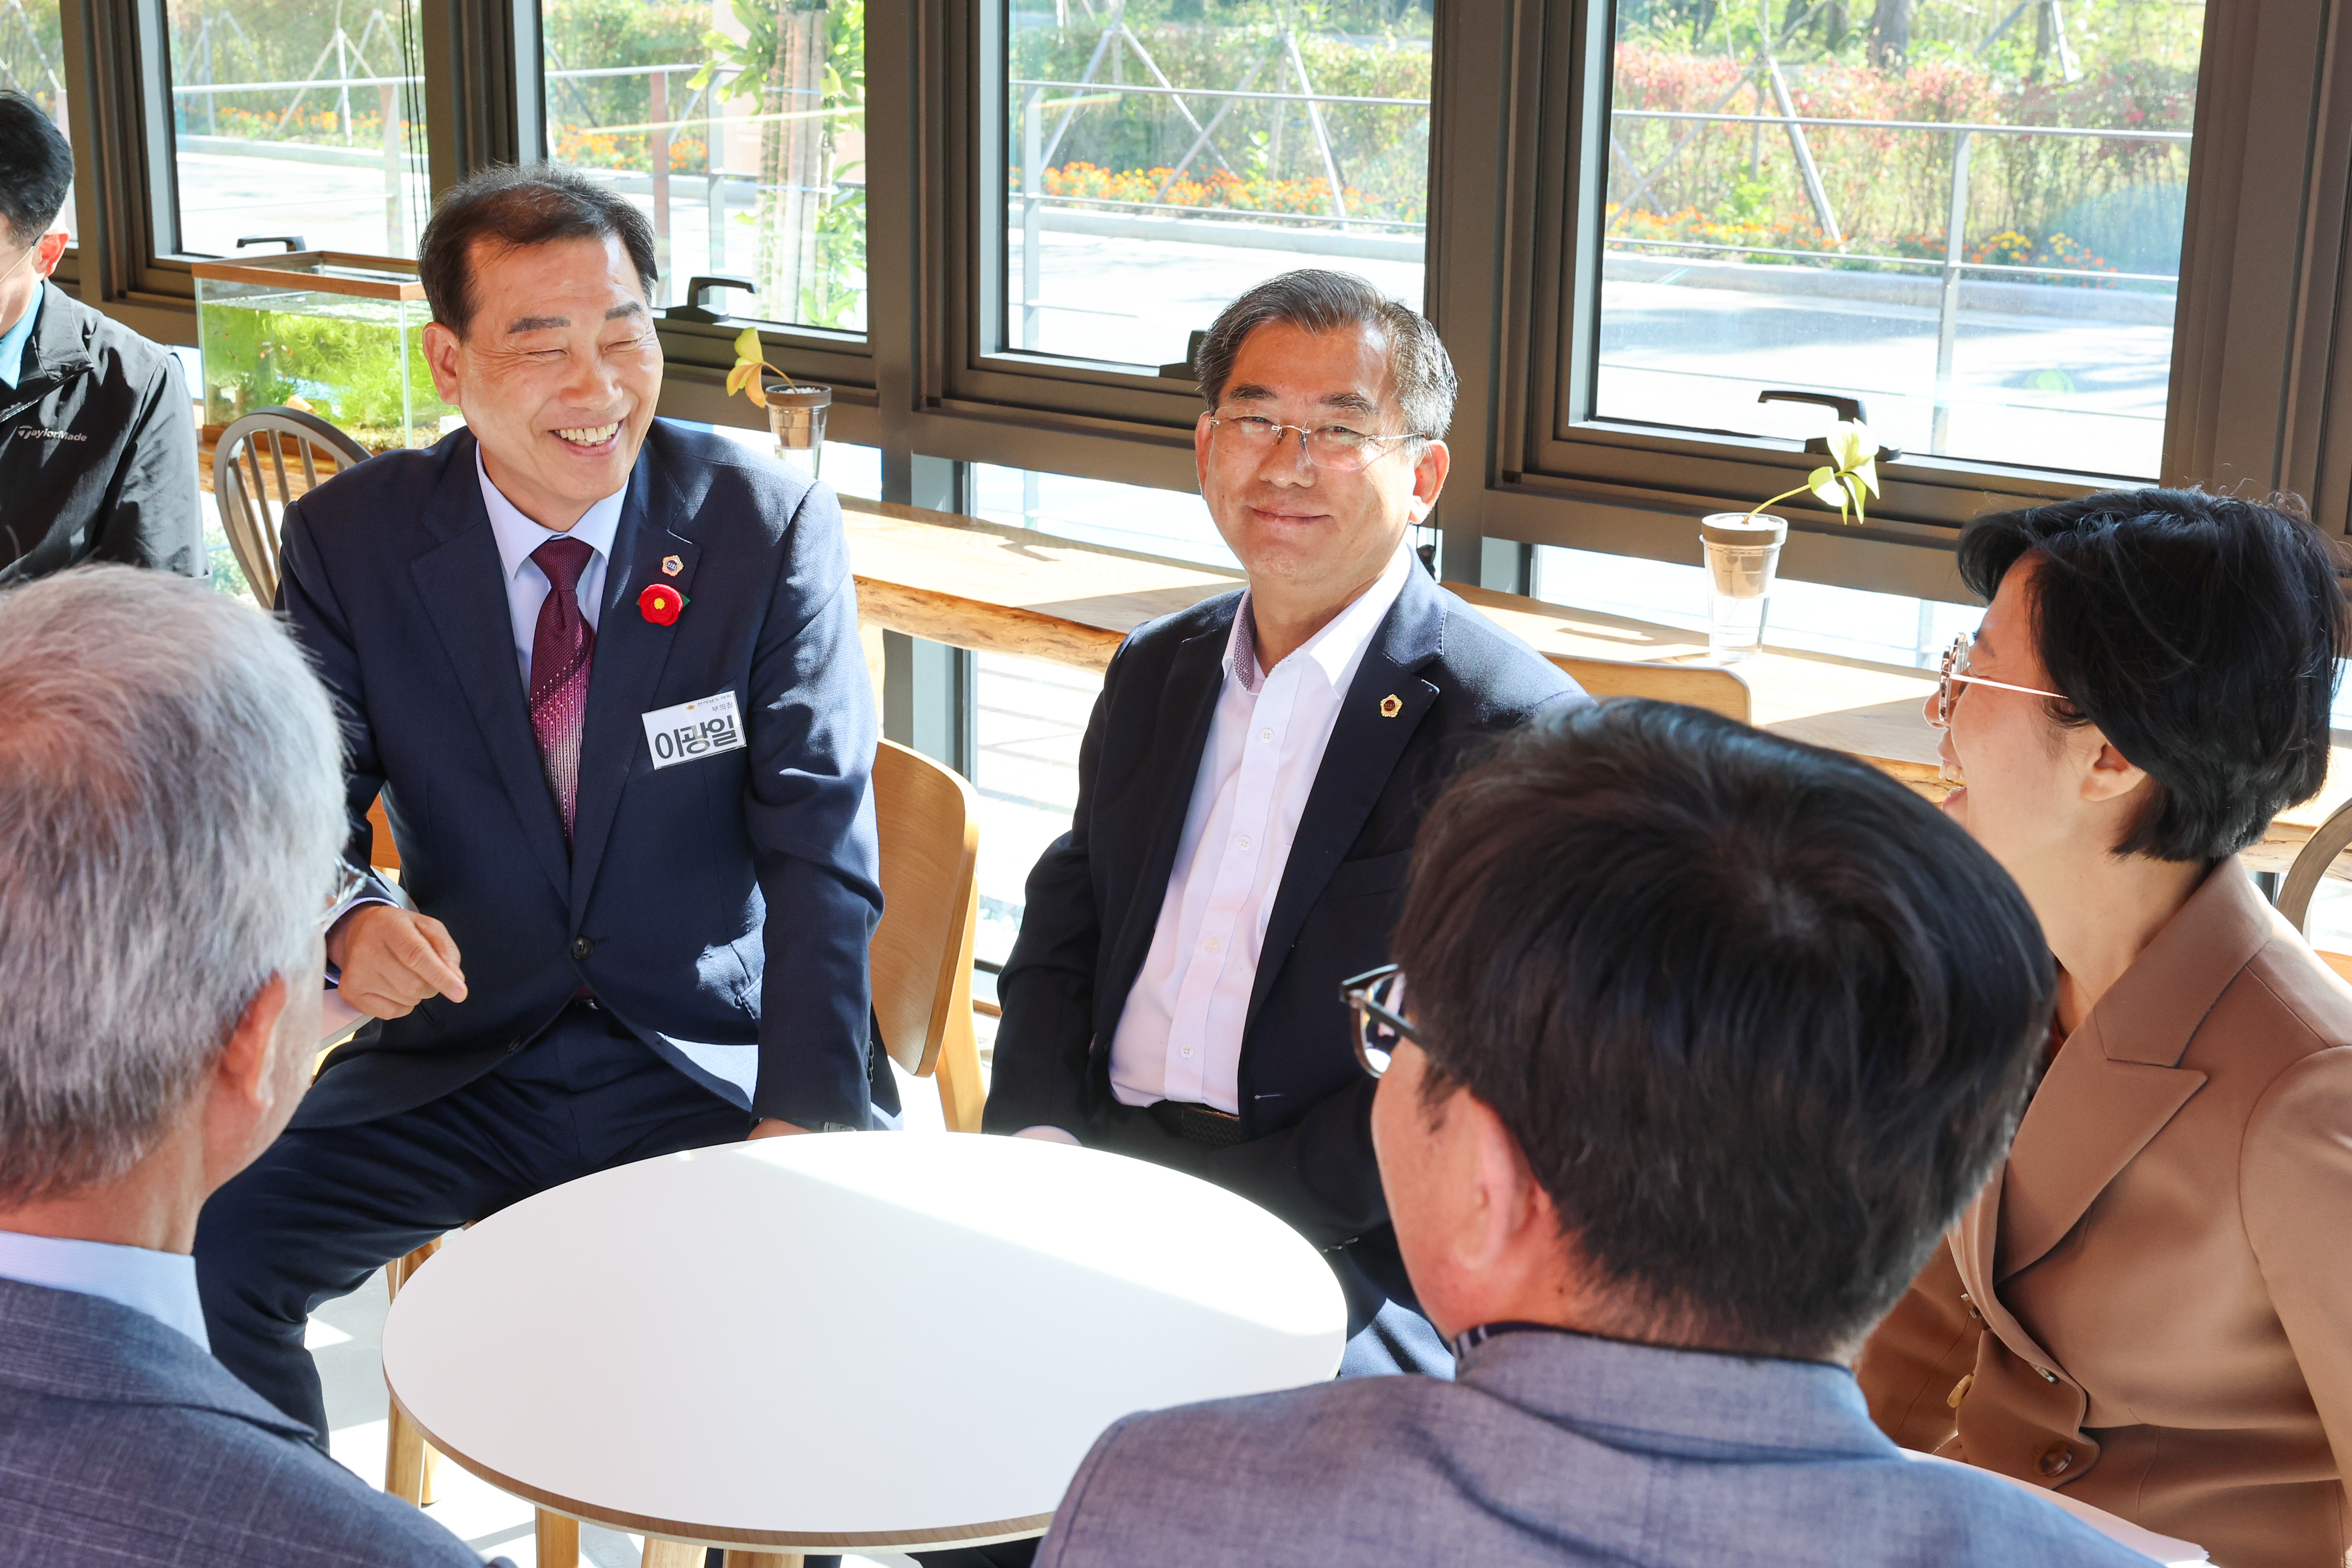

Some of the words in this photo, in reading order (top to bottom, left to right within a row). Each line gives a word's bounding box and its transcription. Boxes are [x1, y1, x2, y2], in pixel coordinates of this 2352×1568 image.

[18, 425, 87, 441] TaylorMade
[712, 702, 733, 712] 부의장
[655, 715, 738, 759] 이광일
